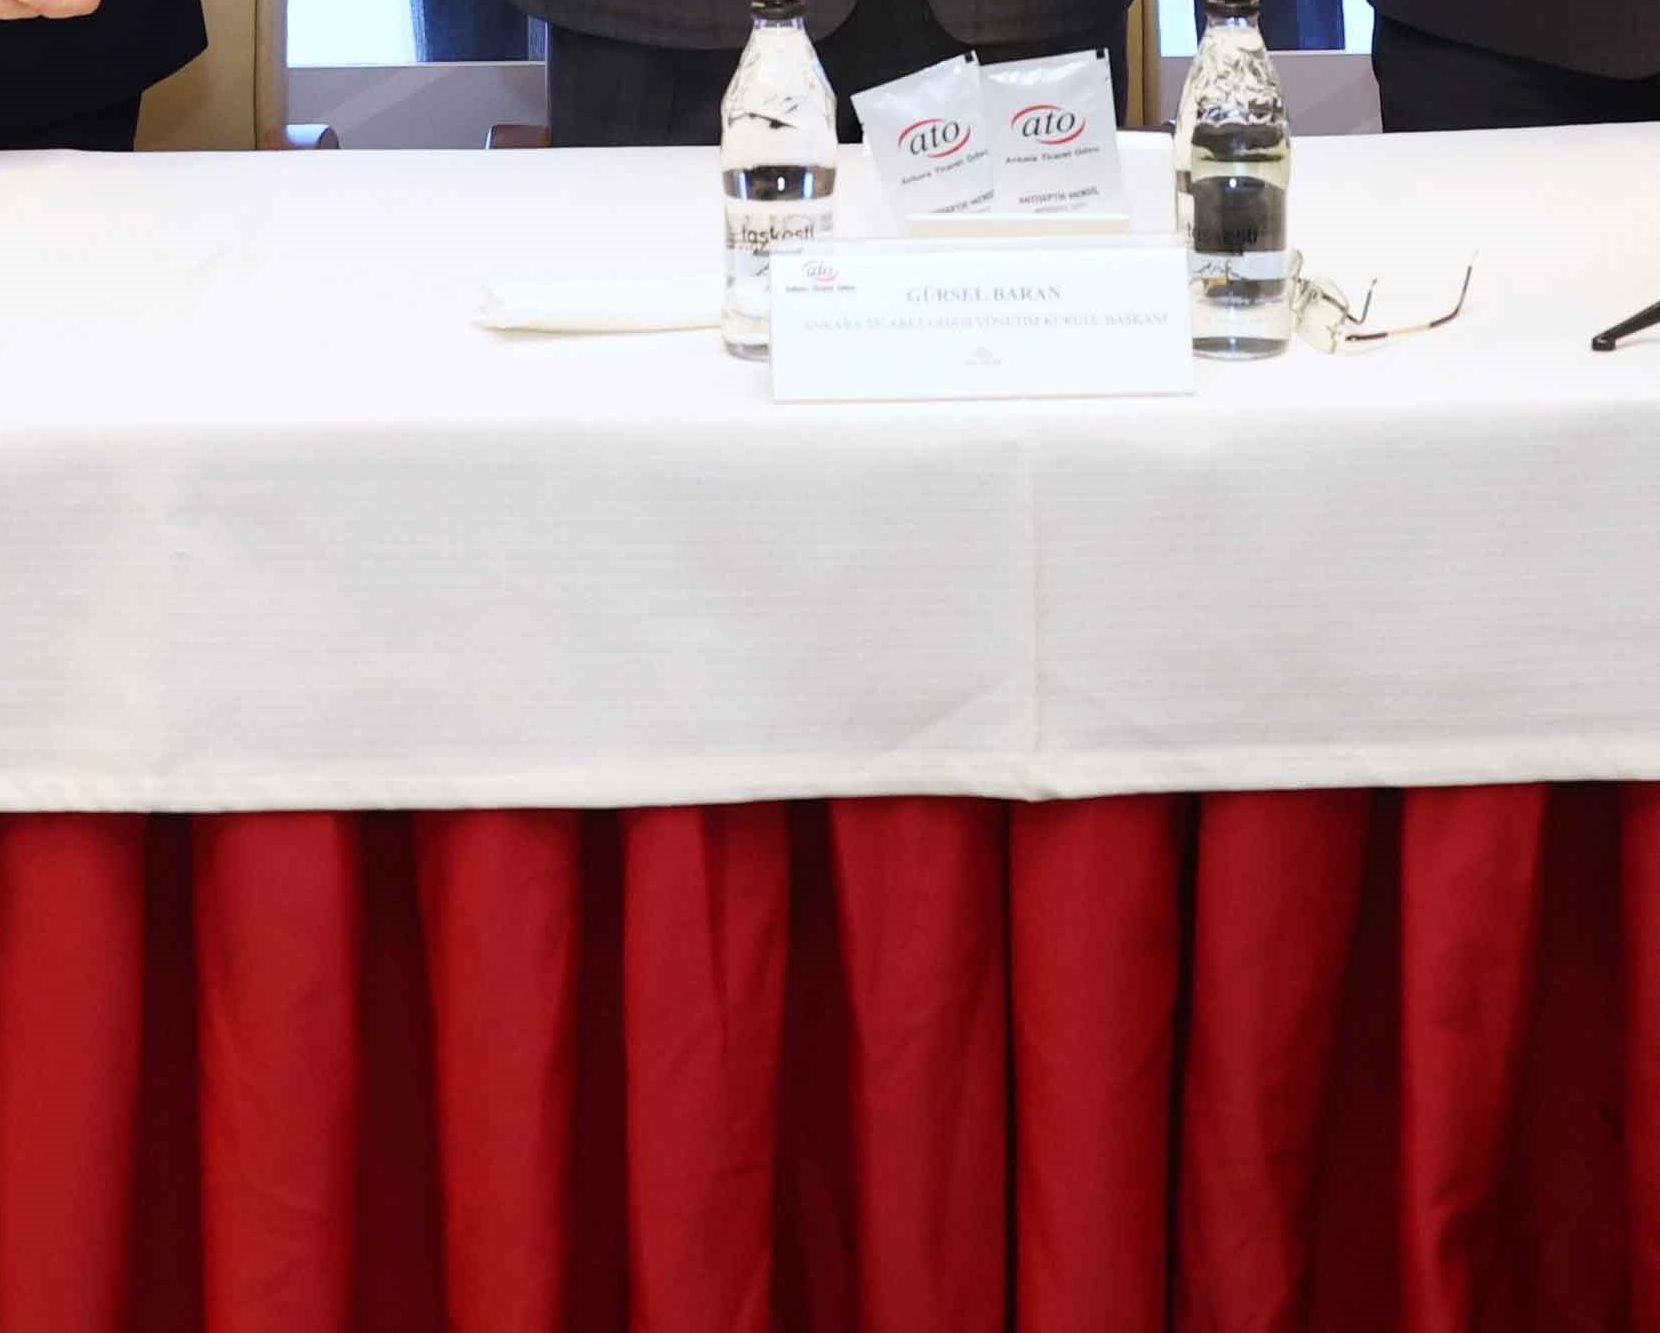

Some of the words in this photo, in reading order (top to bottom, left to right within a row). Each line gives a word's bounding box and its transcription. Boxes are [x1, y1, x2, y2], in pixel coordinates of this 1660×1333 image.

[909, 120, 961, 156] ato
[1021, 109, 1076, 138] ato
[992, 285, 1063, 303] BARAN
